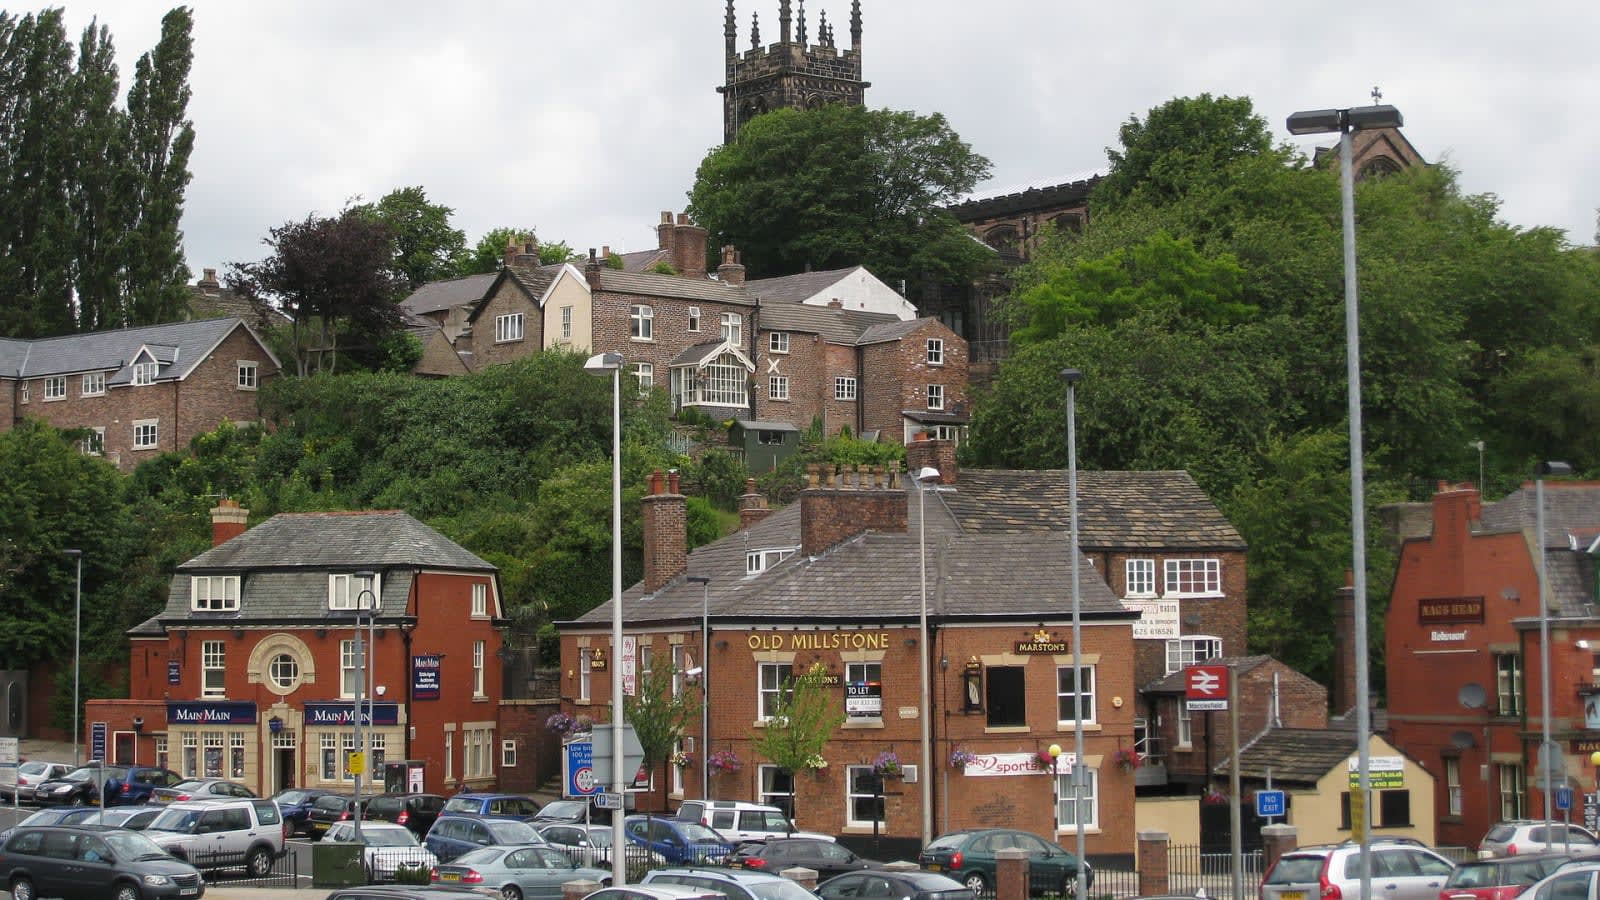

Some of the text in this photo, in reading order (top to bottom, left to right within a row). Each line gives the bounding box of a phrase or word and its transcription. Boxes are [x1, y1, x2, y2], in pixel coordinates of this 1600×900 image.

[1451, 603, 1481, 616] HEAD
[748, 633, 890, 650] OLD MILLSTONE
[1019, 643, 1066, 652] MARSTON'S
[176, 709, 231, 720] MAIN MAIN
[314, 710, 370, 721] MAIN MIN
[997, 761, 1038, 774] sports
[1264, 795, 1277, 803] NO
[1263, 804, 1279, 812] EXIT
